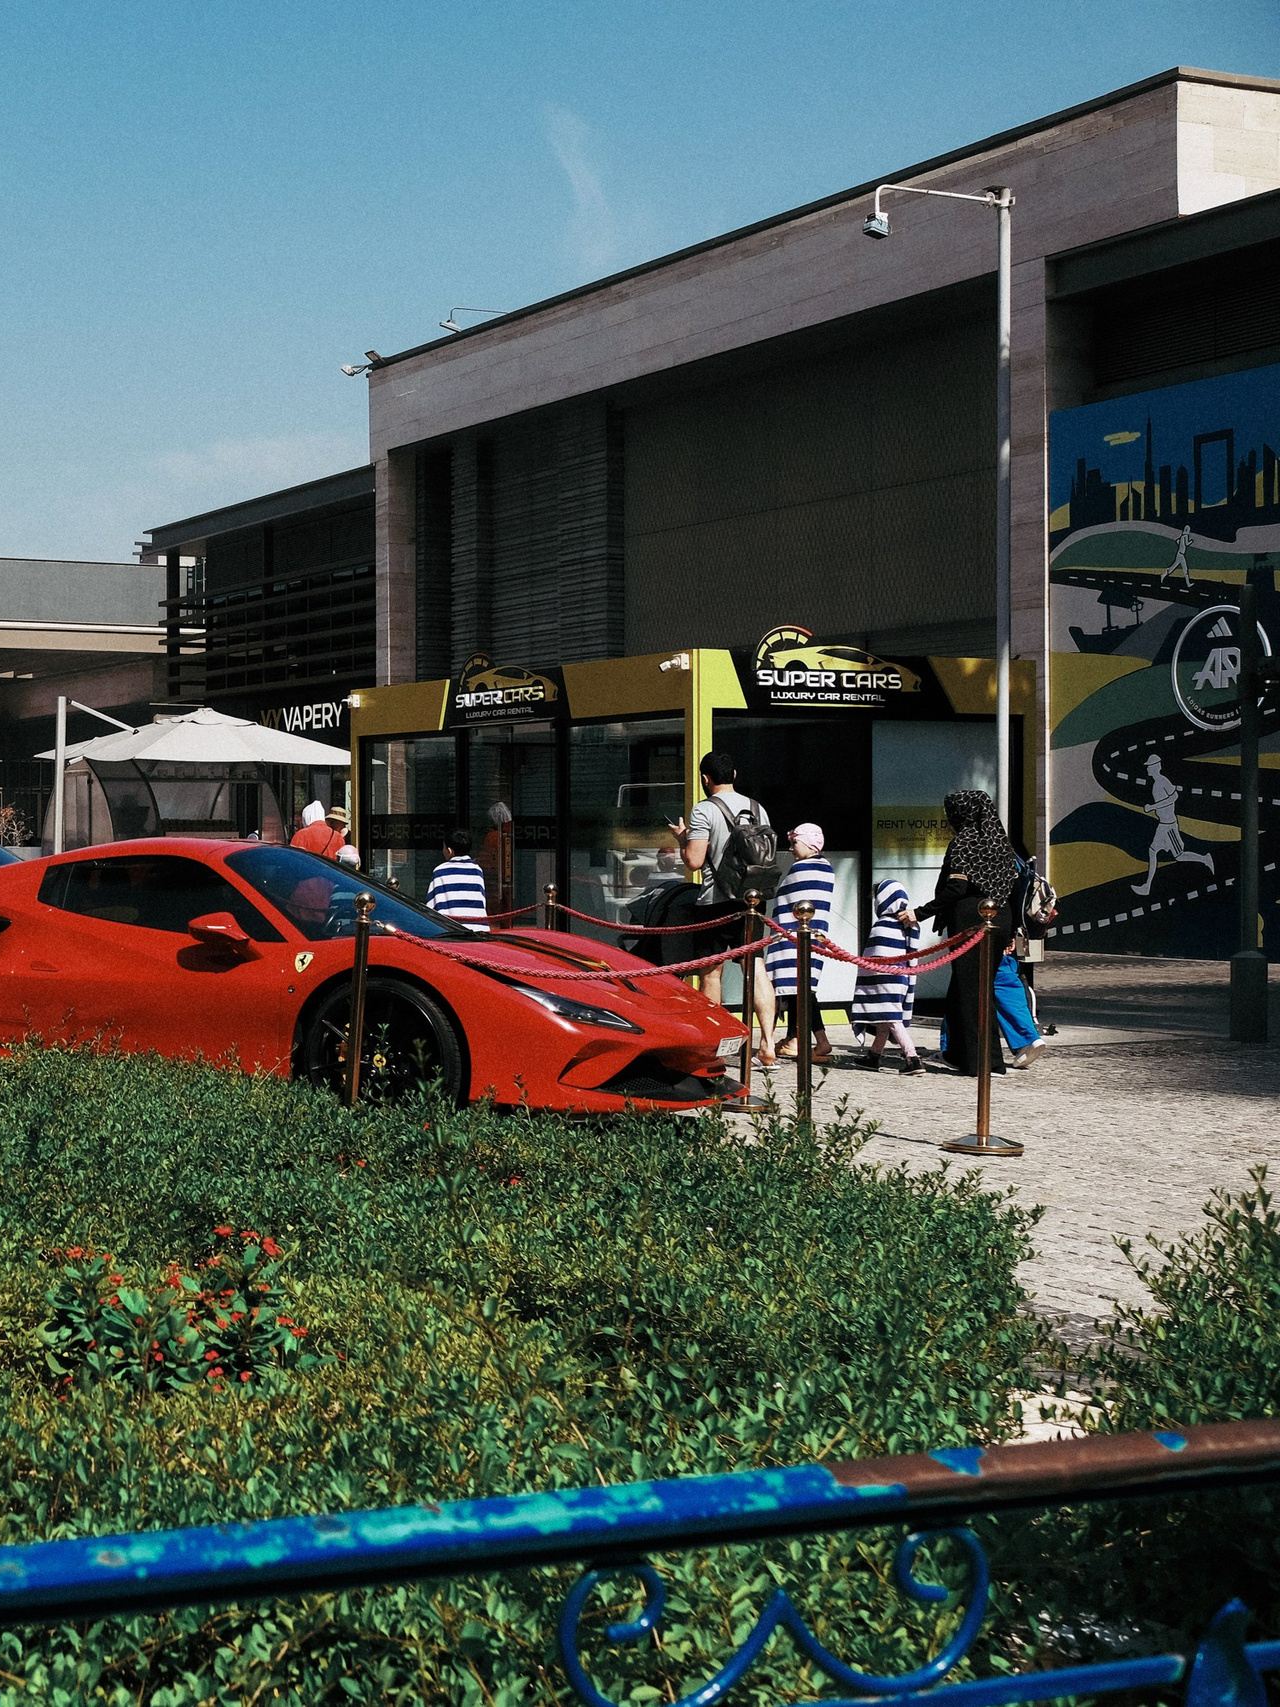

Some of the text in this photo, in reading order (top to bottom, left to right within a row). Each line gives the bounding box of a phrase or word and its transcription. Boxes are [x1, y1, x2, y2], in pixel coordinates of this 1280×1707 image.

[756, 669, 903, 690] SUPER CARS
[455, 686, 545, 709] SUPER CARS
[770, 691, 886, 702] LUXURY CAR RENTAL
[465, 706, 534, 719] LUXURY CAR RENTAL
[1186, 695, 1235, 720] ADIDAS RUNNERS
[282, 702, 342, 732] VAPERY
[371, 824, 447, 840] SUPER CARS
[876, 820, 905, 829] RENT
[907, 820, 937, 829] YOUR
